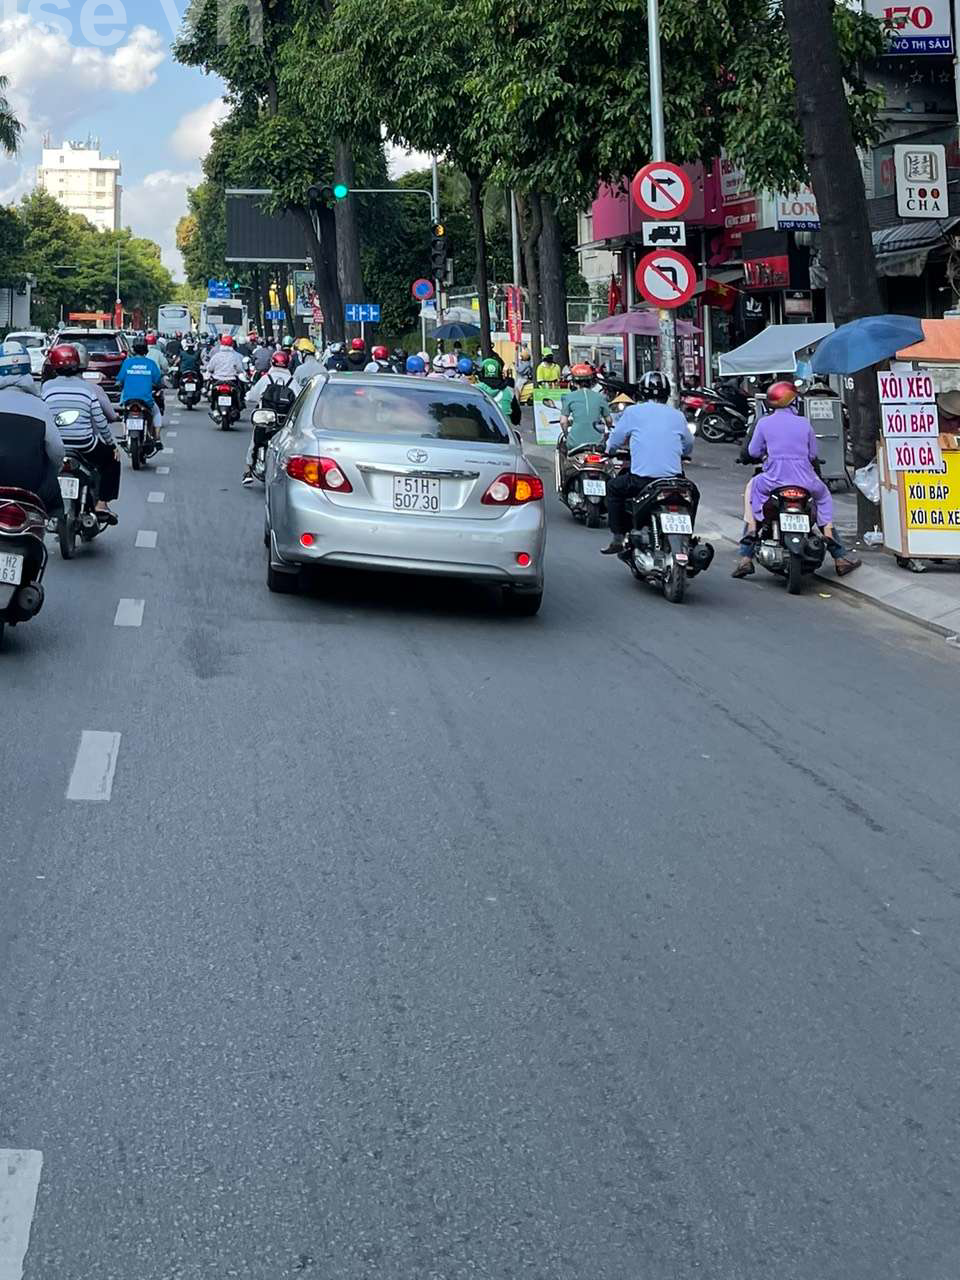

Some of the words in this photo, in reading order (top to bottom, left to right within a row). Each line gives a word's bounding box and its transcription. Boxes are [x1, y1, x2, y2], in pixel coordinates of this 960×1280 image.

[883, 6, 934, 30] 170
[912, 40, 927, 51] THỊ
[906, 187, 940, 199] TOO
[906, 199, 940, 212] CHA
[880, 372, 903, 398] XÔI
[906, 372, 933, 398] XÉO
[887, 409, 907, 433] XÔI
[910, 407, 934, 433] BẮP
[896, 441, 916, 466] XÔI
[919, 441, 935, 466] GÀ
[403, 478, 430, 494] 51H
[909, 482, 926, 500] XÔI
[929, 480, 949, 500] BẮP
[394, 494, 439, 511] 507.30
[910, 507, 927, 525] XÔI
[931, 507, 944, 525] GÀ
